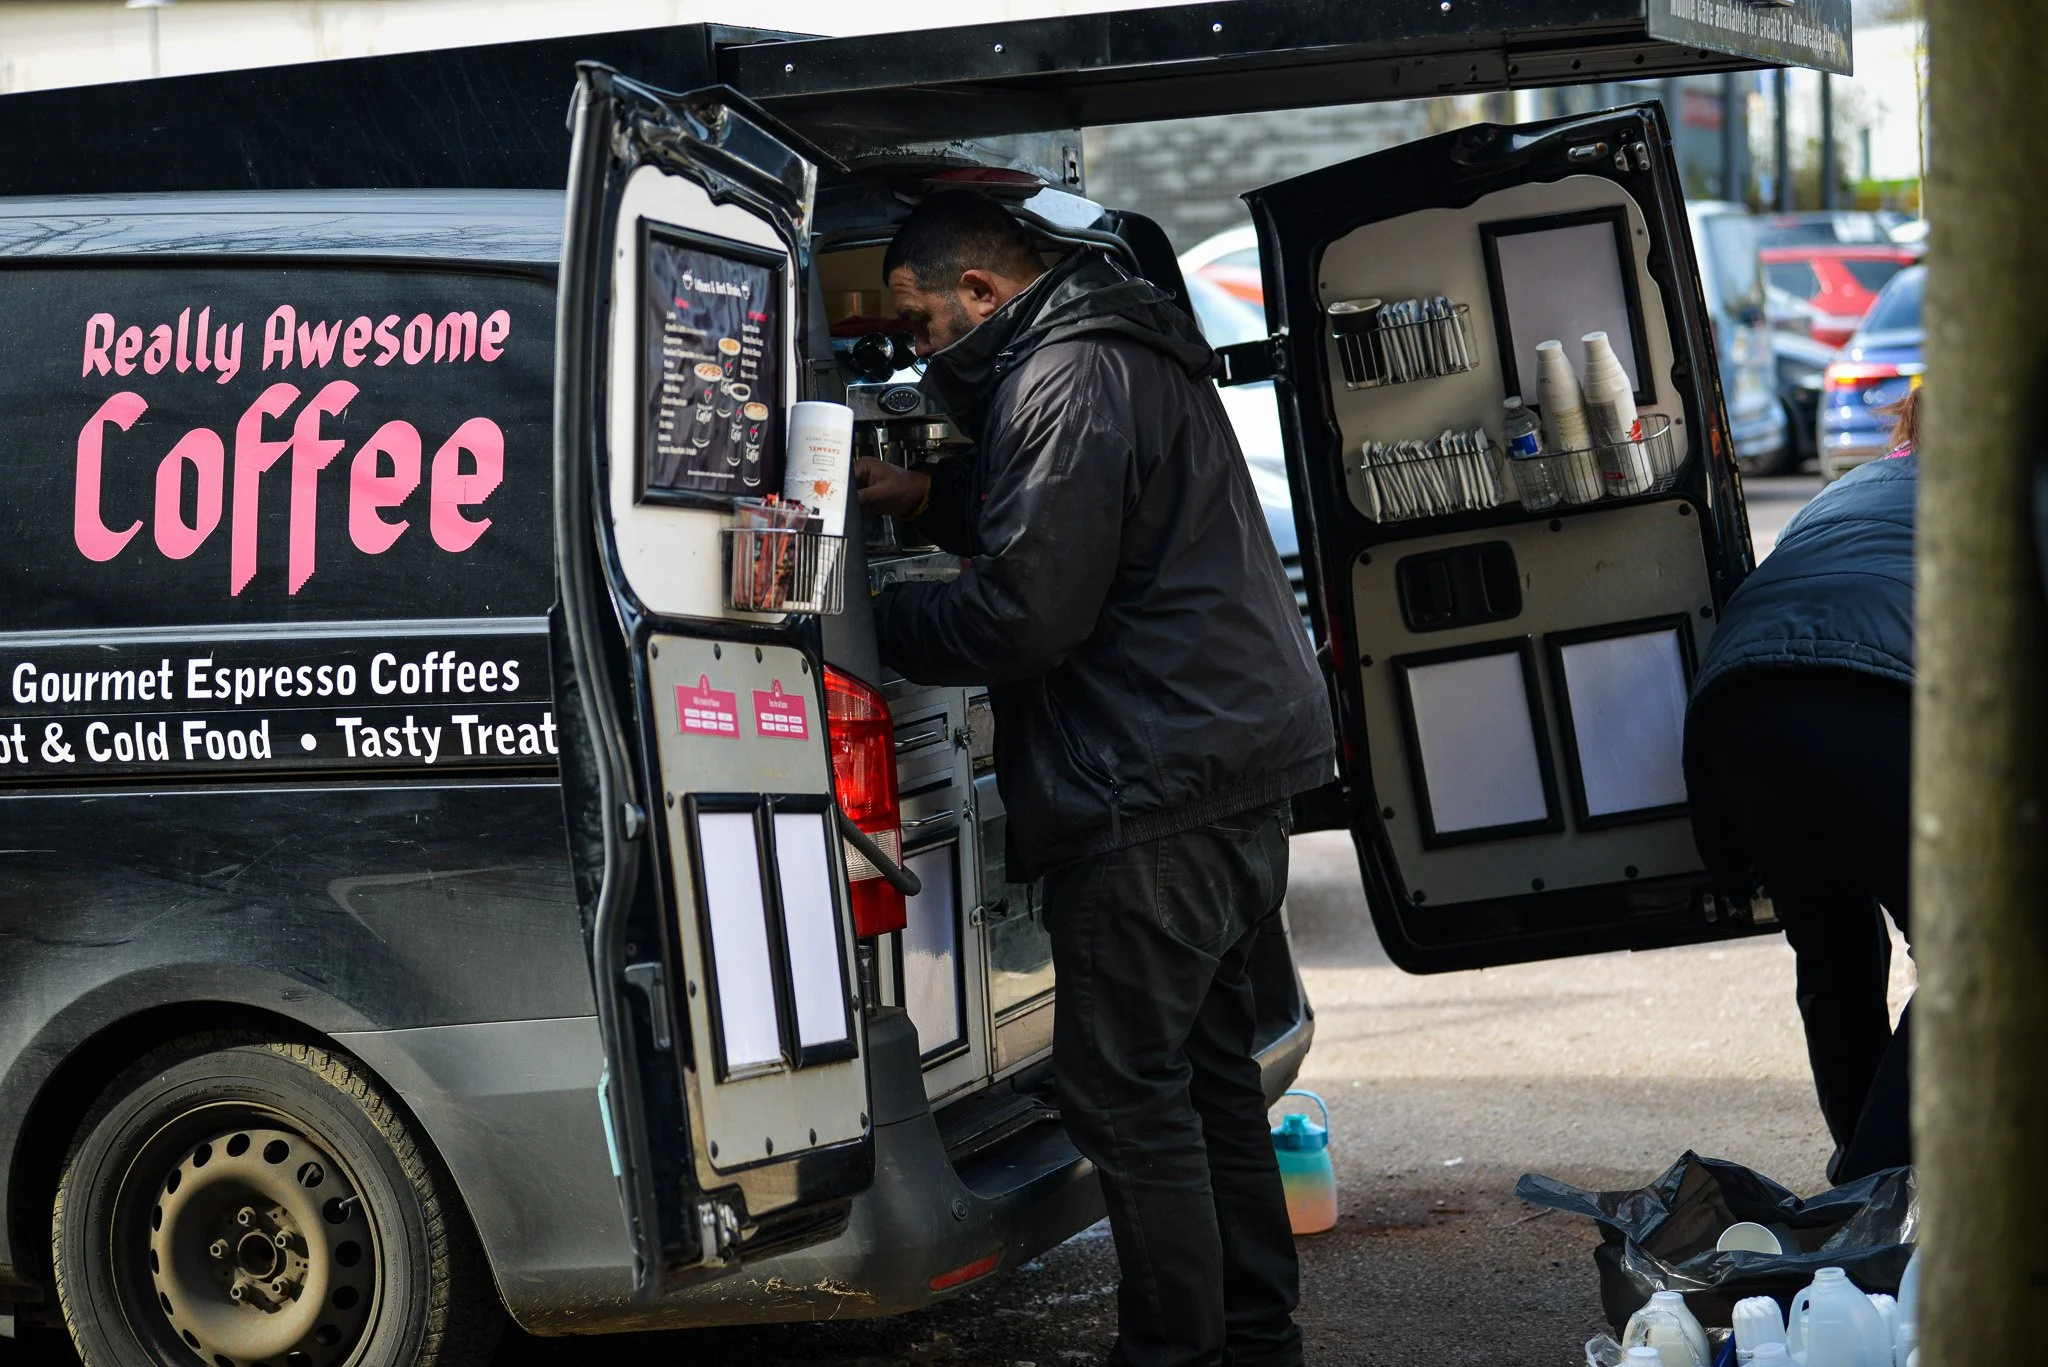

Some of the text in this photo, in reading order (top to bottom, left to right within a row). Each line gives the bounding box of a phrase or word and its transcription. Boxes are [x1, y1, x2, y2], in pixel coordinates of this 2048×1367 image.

[1715, 0, 1745, 34] available
[1760, 11, 1780, 41] events
[1788, 14, 1822, 50] Conference
[82, 304, 511, 385] Really Awesome
[74, 379, 505, 597] Coffee
[12, 651, 520, 705] Gourmet Espresso Coffees
[41, 722, 76, 763] &
[85, 721, 170, 762] Cold
[182, 719, 272, 761] Food
[335, 714, 442, 764] Tasty
[451, 712, 559, 755] Treat
